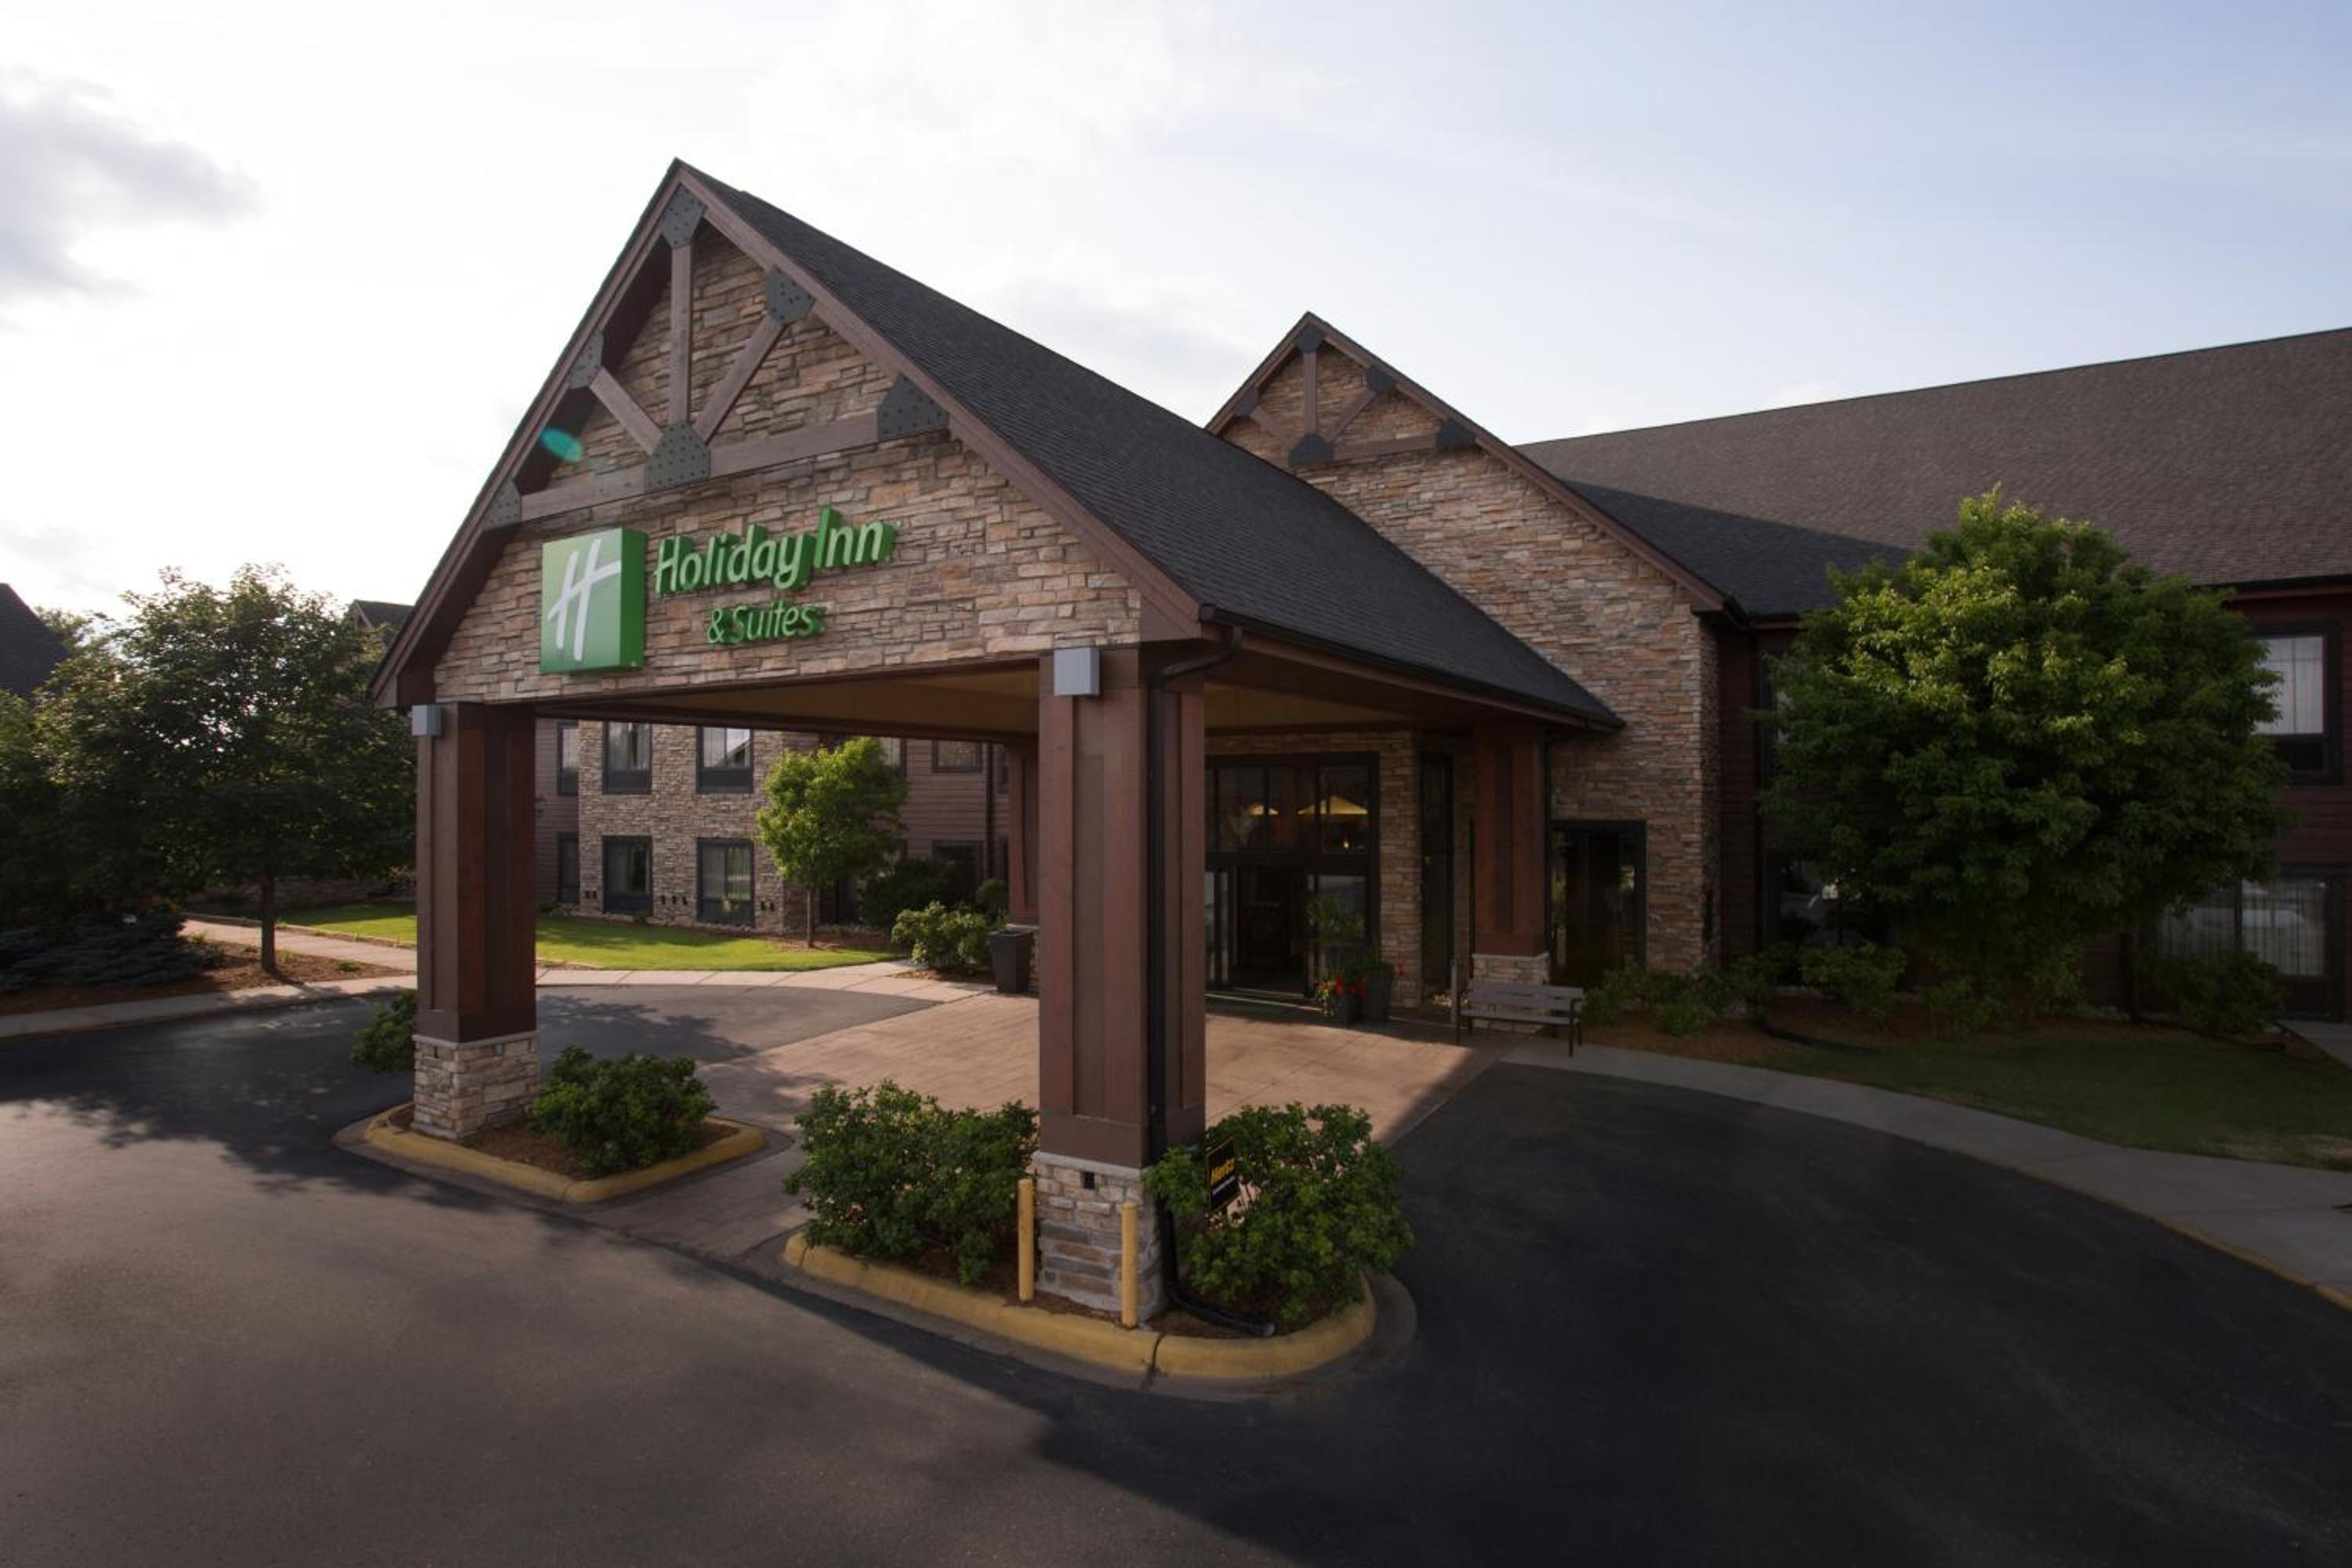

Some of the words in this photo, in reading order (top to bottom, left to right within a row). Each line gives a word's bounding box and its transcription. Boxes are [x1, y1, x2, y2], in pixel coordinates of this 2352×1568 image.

[653, 523, 808, 594] Holiday
[813, 506, 887, 568] Inn
[706, 607, 724, 644] &
[730, 600, 816, 642] Suites
